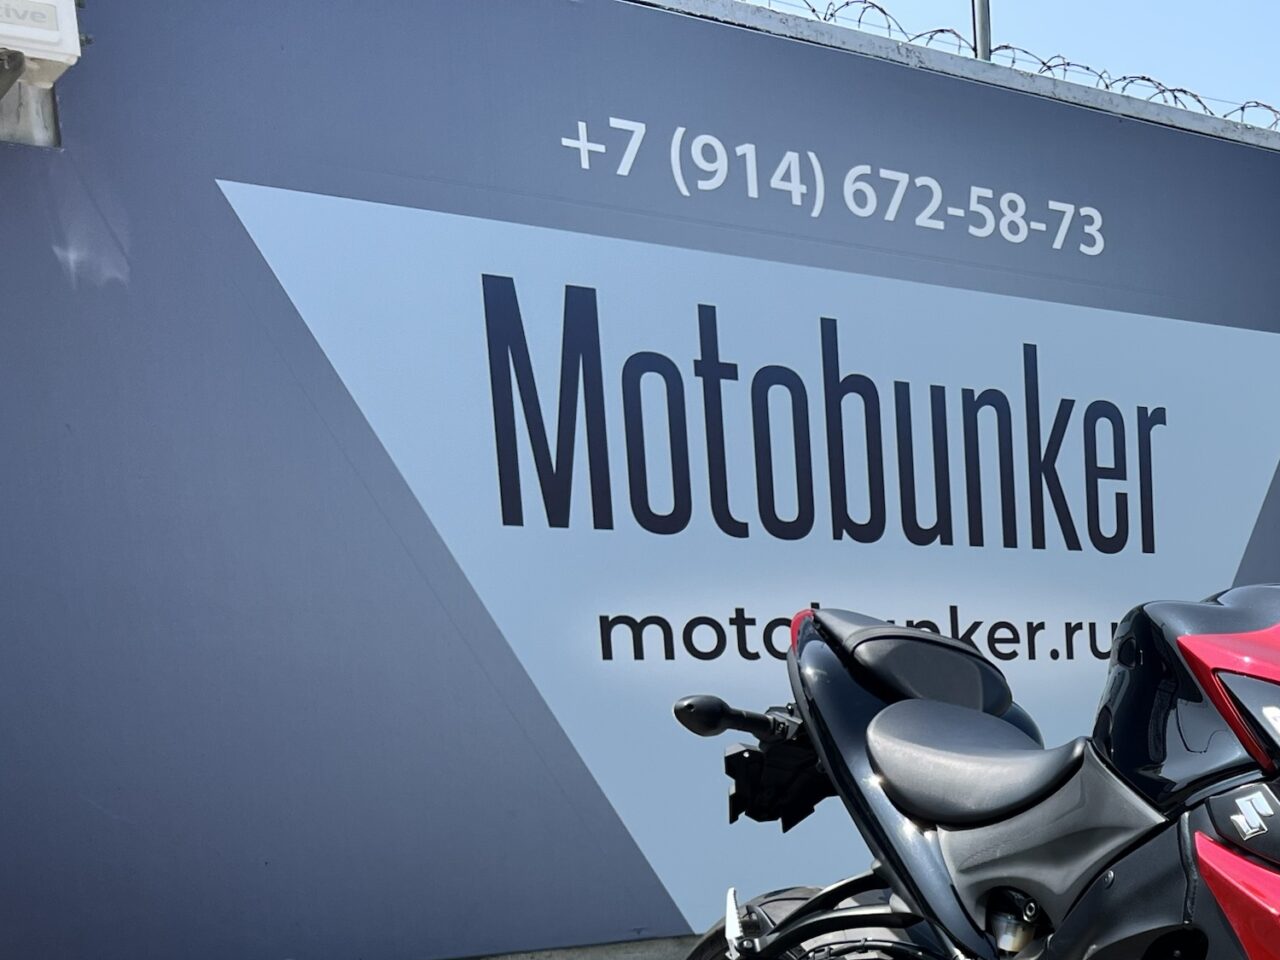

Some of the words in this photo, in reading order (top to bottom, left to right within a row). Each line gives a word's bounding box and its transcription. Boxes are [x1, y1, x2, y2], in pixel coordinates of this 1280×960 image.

[561, 117, 647, 176] +7
[670, 126, 825, 218] (914)
[843, 165, 1106, 256] 672-58-73
[482, 273, 1166, 554] Motobunker
[599, 602, 1119, 661] motoker.ru
